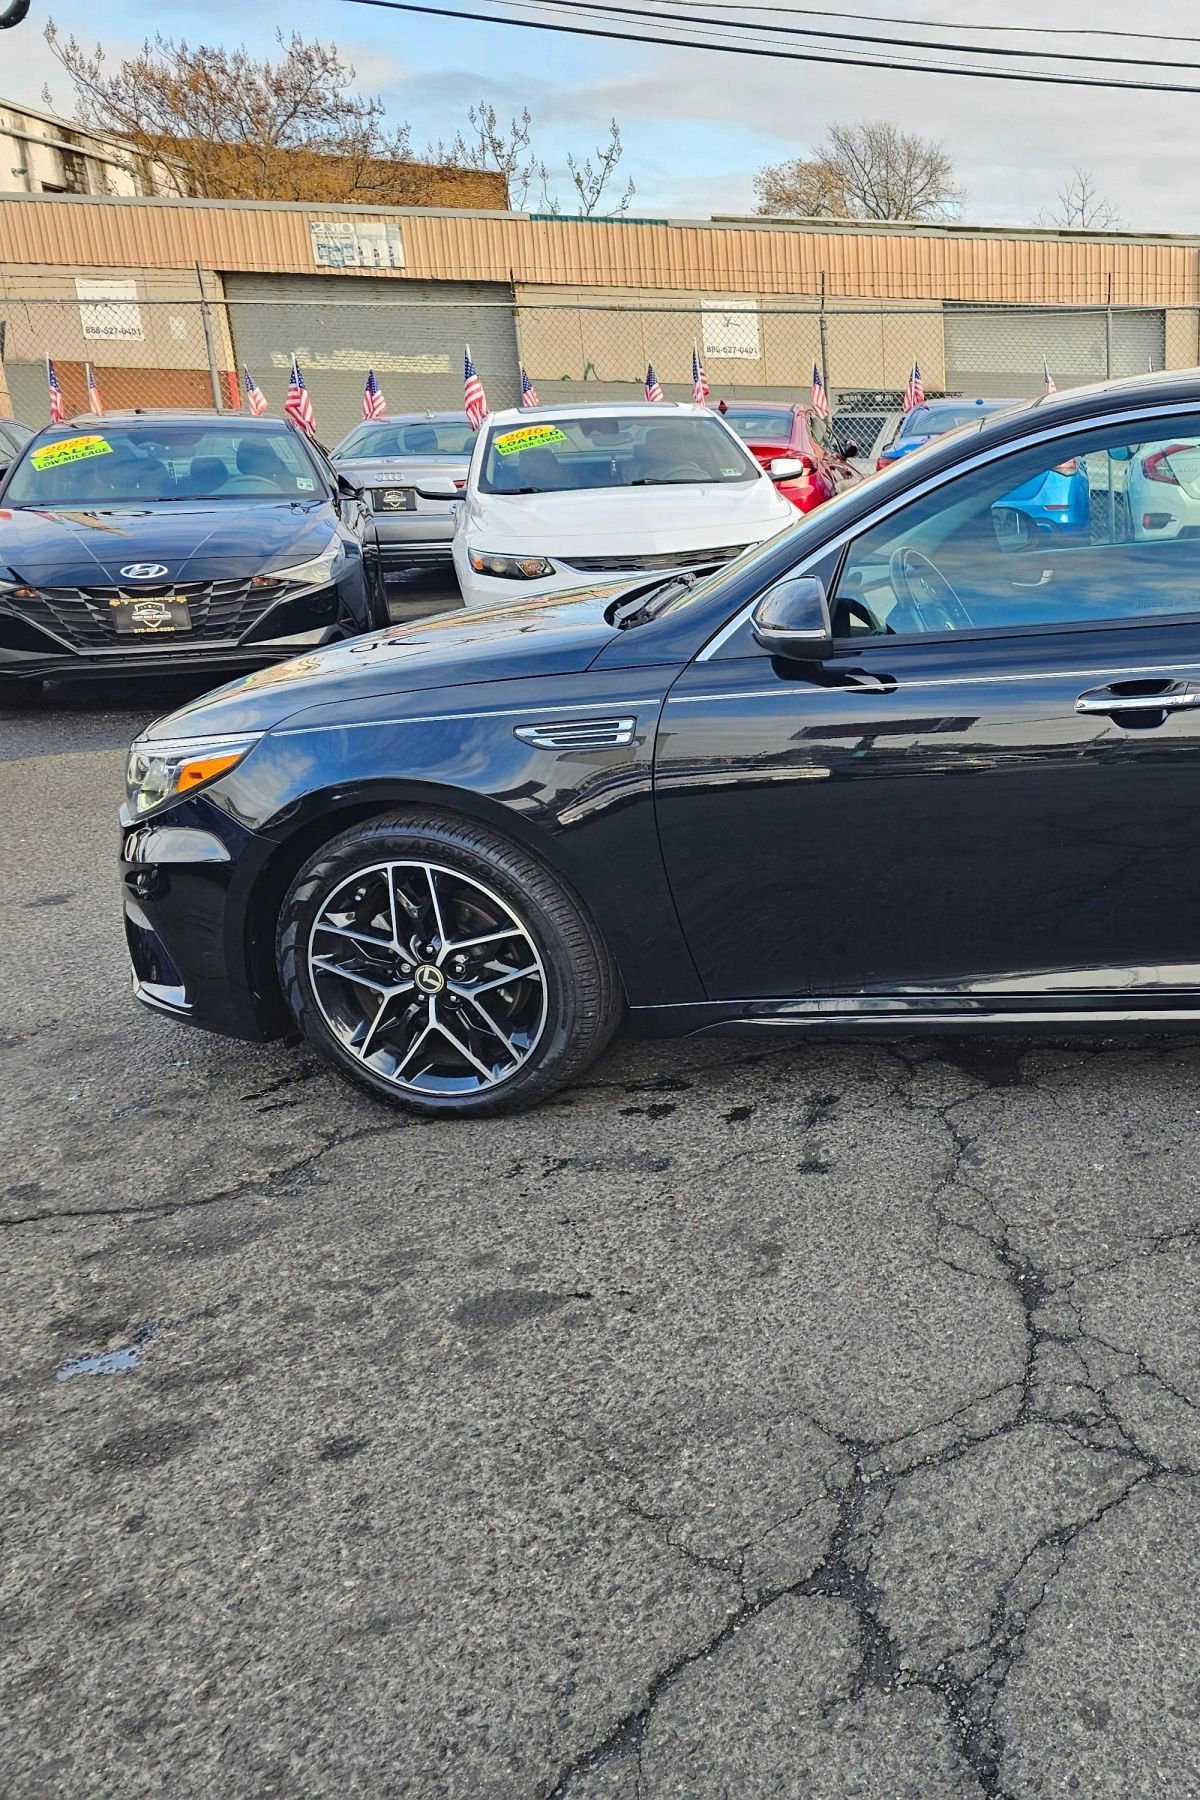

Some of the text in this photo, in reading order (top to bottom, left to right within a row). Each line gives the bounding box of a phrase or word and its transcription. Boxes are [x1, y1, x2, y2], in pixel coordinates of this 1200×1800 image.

[498, 431, 558, 449] LOADED
[505, 428, 543, 442] 2016
[43, 445, 96, 461] SALE
[501, 434, 564, 455] REARVIEW CAMERA
[37, 447, 108, 469] LOW MILEAGE
